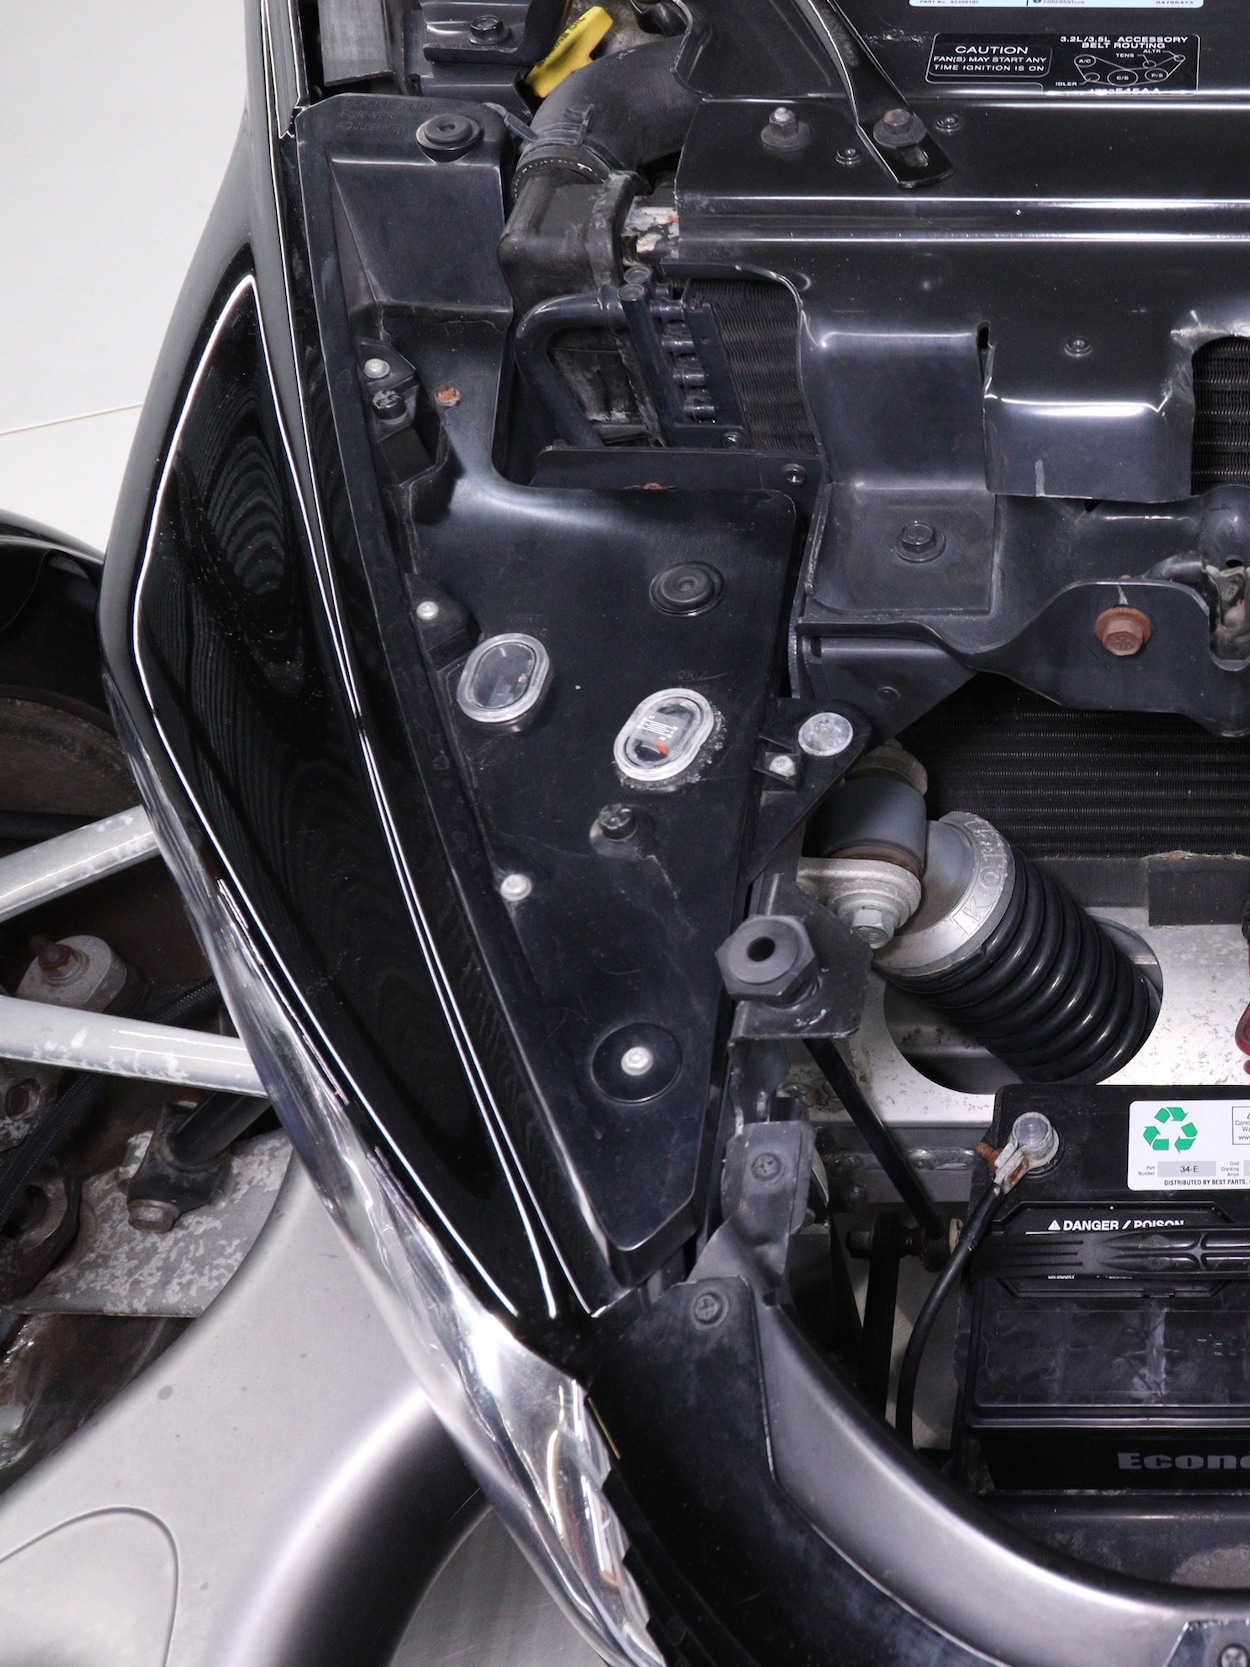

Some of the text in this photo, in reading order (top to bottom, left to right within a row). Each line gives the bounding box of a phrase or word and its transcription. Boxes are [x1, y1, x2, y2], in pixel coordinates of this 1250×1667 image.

[955, 46, 1028, 55] CAUTION
[1180, 1165, 1199, 1173] 34-E
[1063, 1220, 1119, 1231] DANGER
[1122, 1220, 1132, 1230] /
